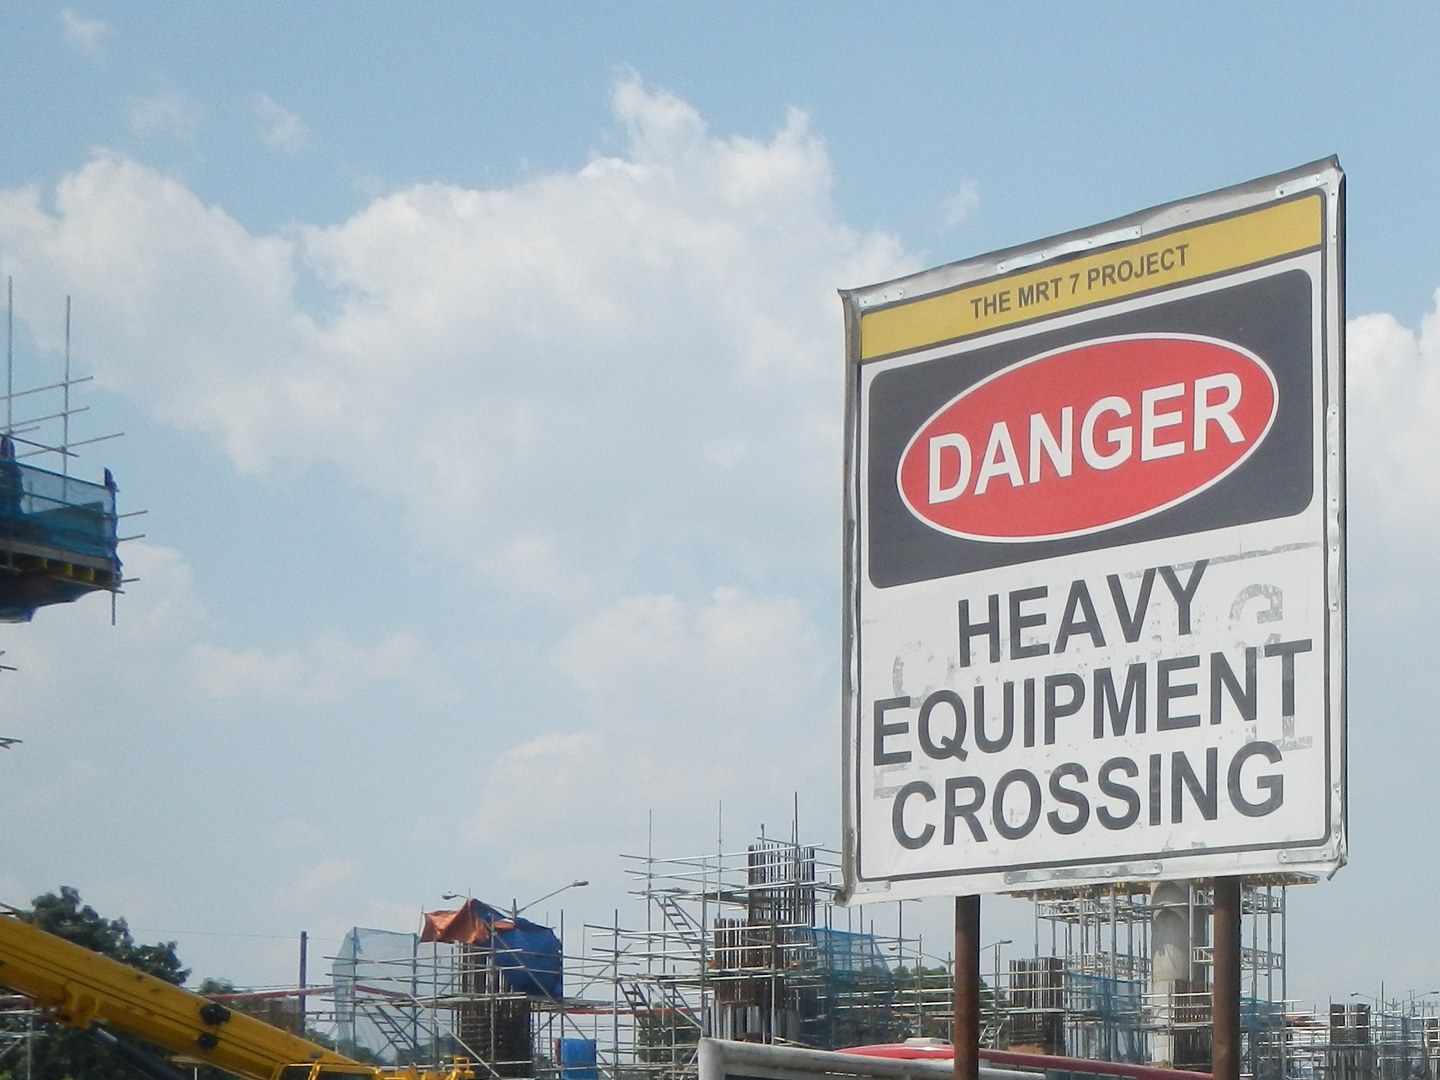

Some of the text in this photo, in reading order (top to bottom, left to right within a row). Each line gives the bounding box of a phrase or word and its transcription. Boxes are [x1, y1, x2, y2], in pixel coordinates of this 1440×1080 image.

[971, 243, 1190, 319] THE MRT 7 PROJECT
[929, 372, 1246, 504] DANGER
[957, 559, 1210, 668] HEAVY
[873, 638, 1313, 766] EQUIPMENT
[892, 740, 1284, 850] CROSSING
